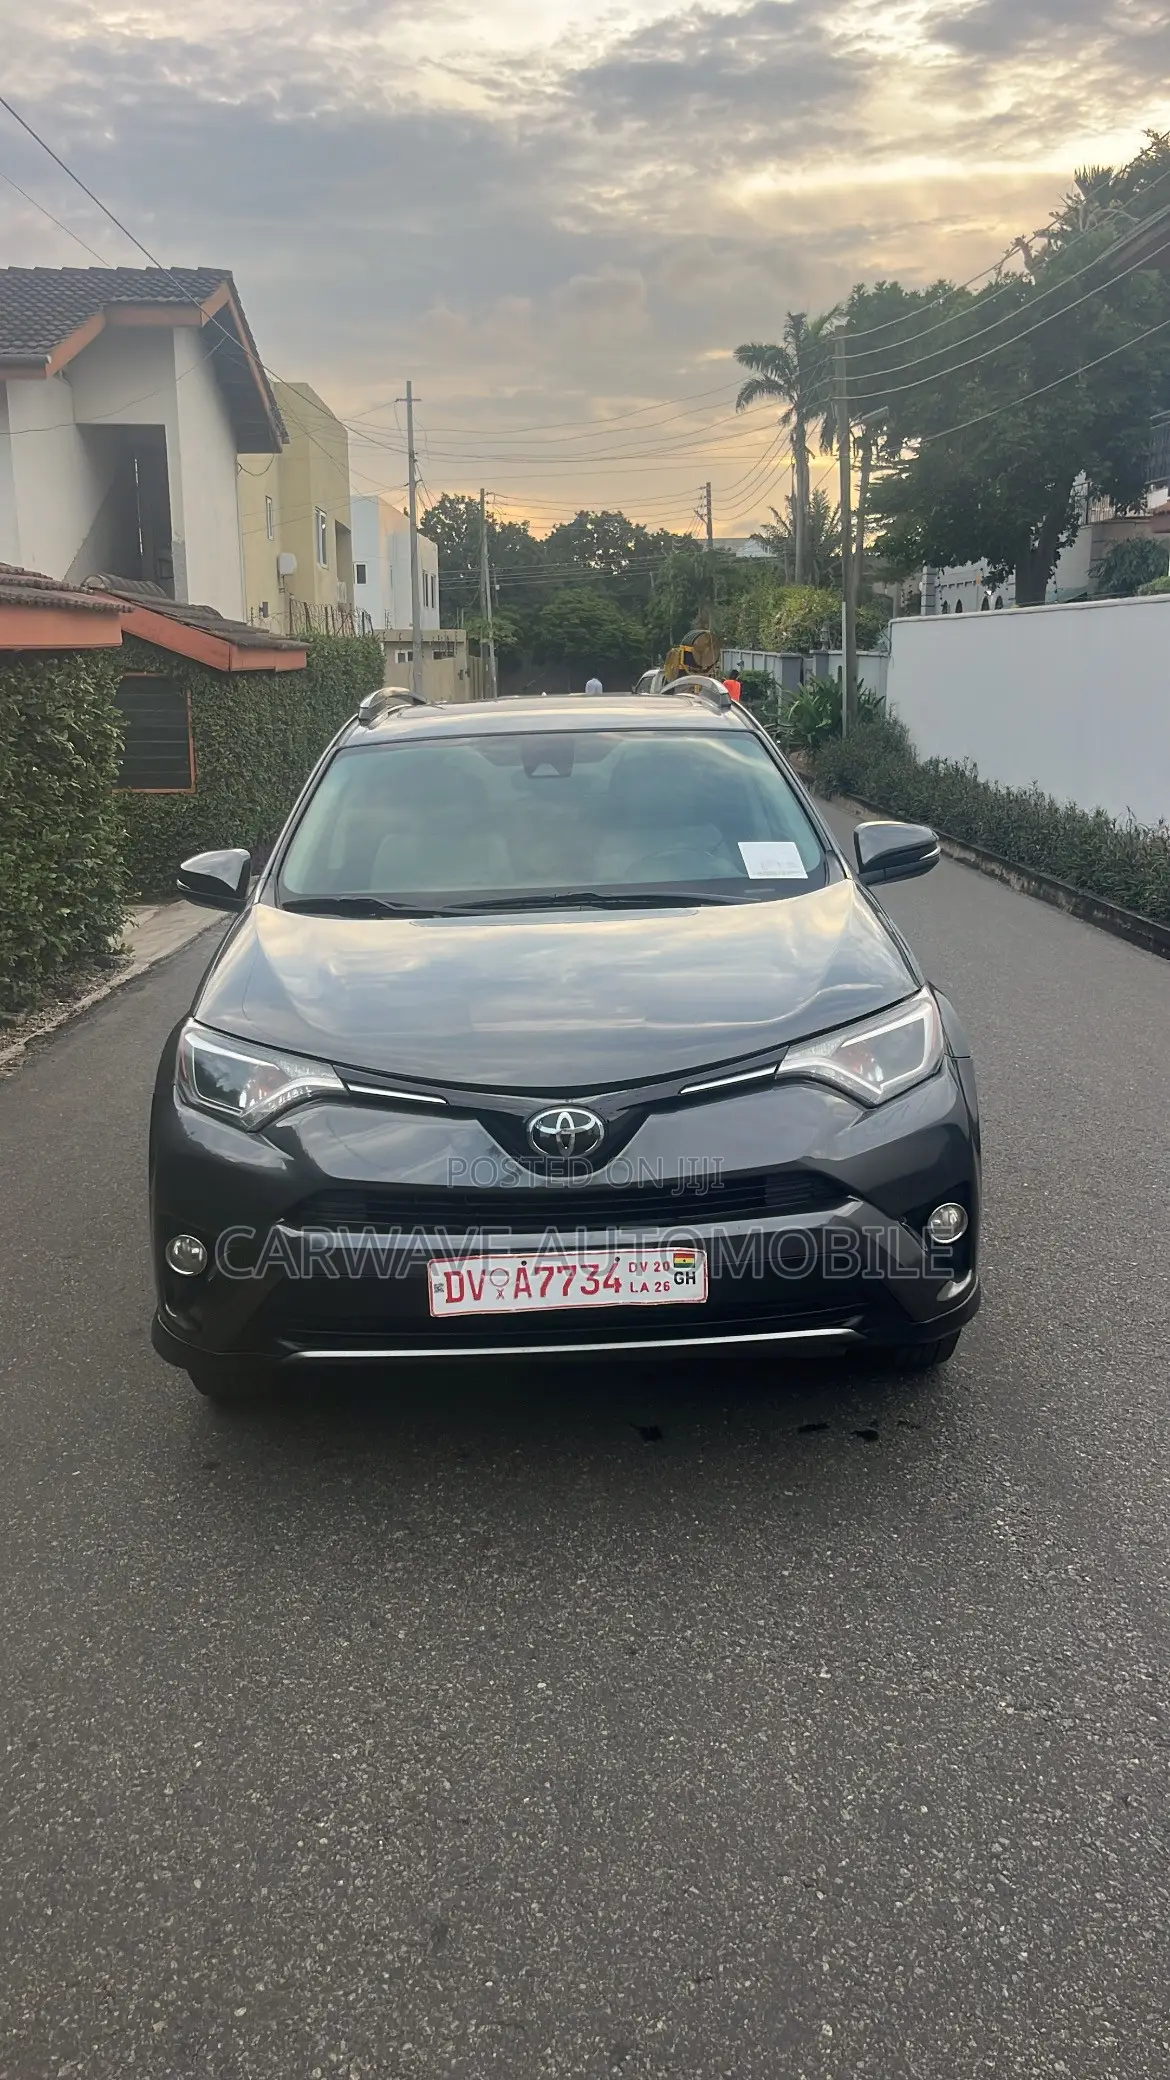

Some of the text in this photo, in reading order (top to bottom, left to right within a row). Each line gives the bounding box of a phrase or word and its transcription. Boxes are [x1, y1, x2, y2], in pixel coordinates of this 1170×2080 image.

[628, 1260, 670, 1273] DV 20
[444, 1263, 621, 1304] DV A7734
[673, 1271, 696, 1286] GH
[630, 1280, 671, 1293] LA 26
